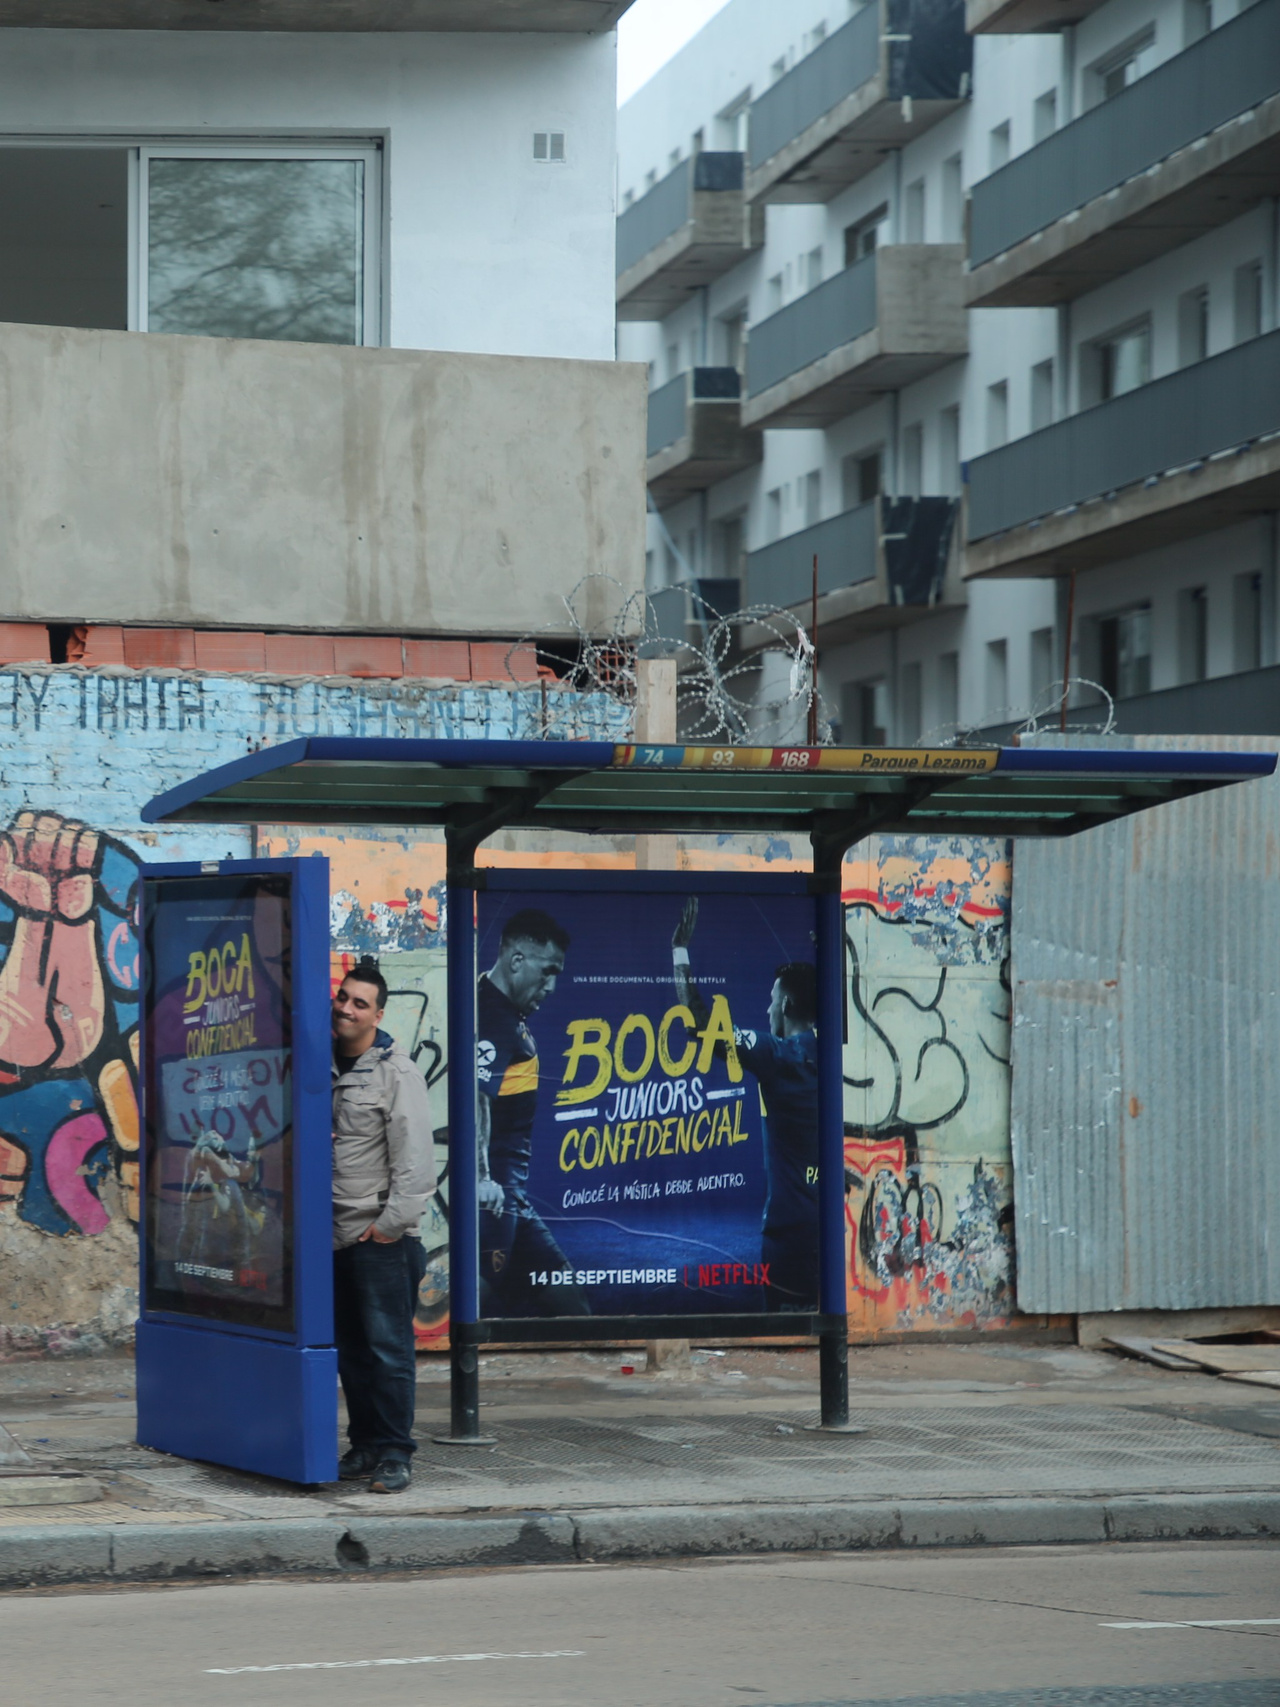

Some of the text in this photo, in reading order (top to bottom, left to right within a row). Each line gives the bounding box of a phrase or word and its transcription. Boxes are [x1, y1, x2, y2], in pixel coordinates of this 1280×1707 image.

[70, 674, 205, 732] TRATA
[644, 749, 664, 766] 74
[711, 750, 735, 767] 93
[781, 750, 810, 768] 168
[861, 752, 987, 770] Parque Lezama
[183, 933, 255, 1014] BOCA
[553, 994, 744, 1107] BOCA
[606, 1077, 704, 1123] JUNIORS
[559, 1100, 749, 1173] CONFIDENCIAL
[562, 1185, 606, 1208] CONOCÉ
[665, 1178, 693, 1195] DESDE
[529, 1268, 677, 1286] 14 DE SEPTIEMBRE
[698, 1263, 771, 1287] NETFLIX
